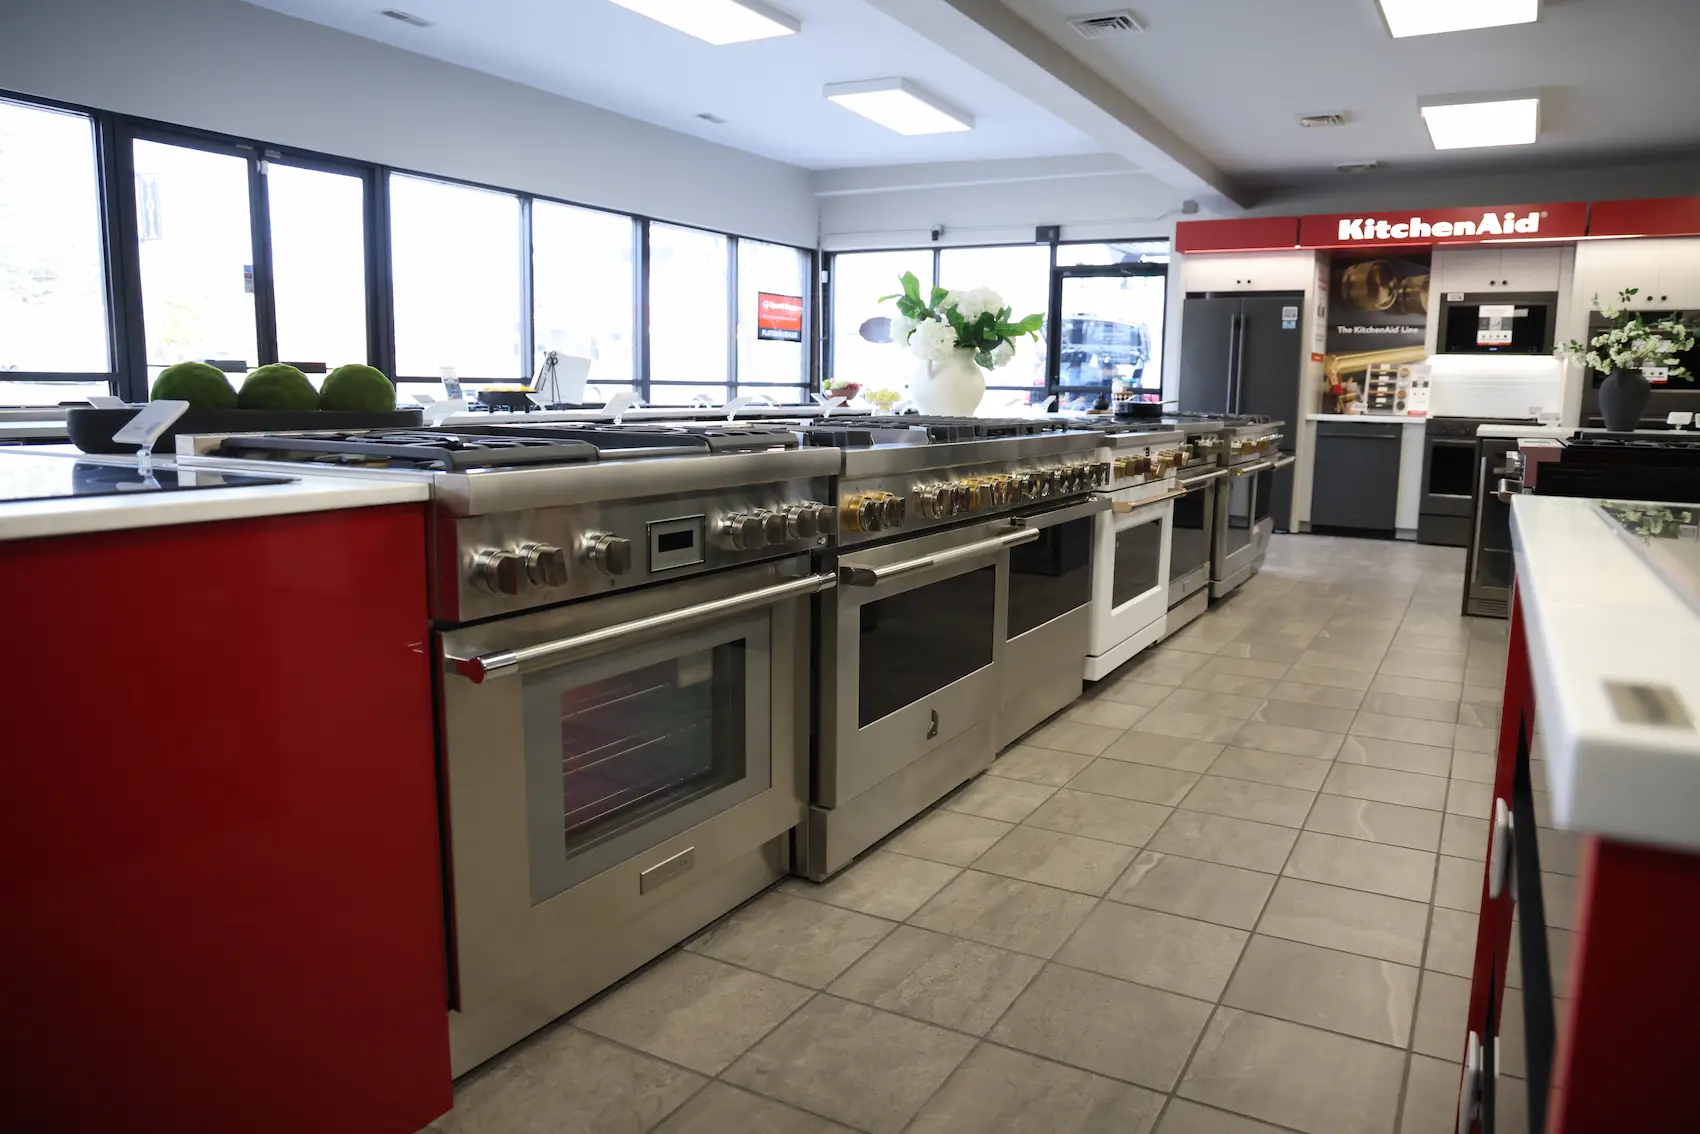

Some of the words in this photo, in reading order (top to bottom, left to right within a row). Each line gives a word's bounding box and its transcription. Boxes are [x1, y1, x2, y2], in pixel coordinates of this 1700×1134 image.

[1338, 212, 1541, 240] KitchenAid
[1337, 325, 1353, 334] The
[1353, 325, 1399, 334] KitchenAid
[1401, 325, 1419, 334] Line
